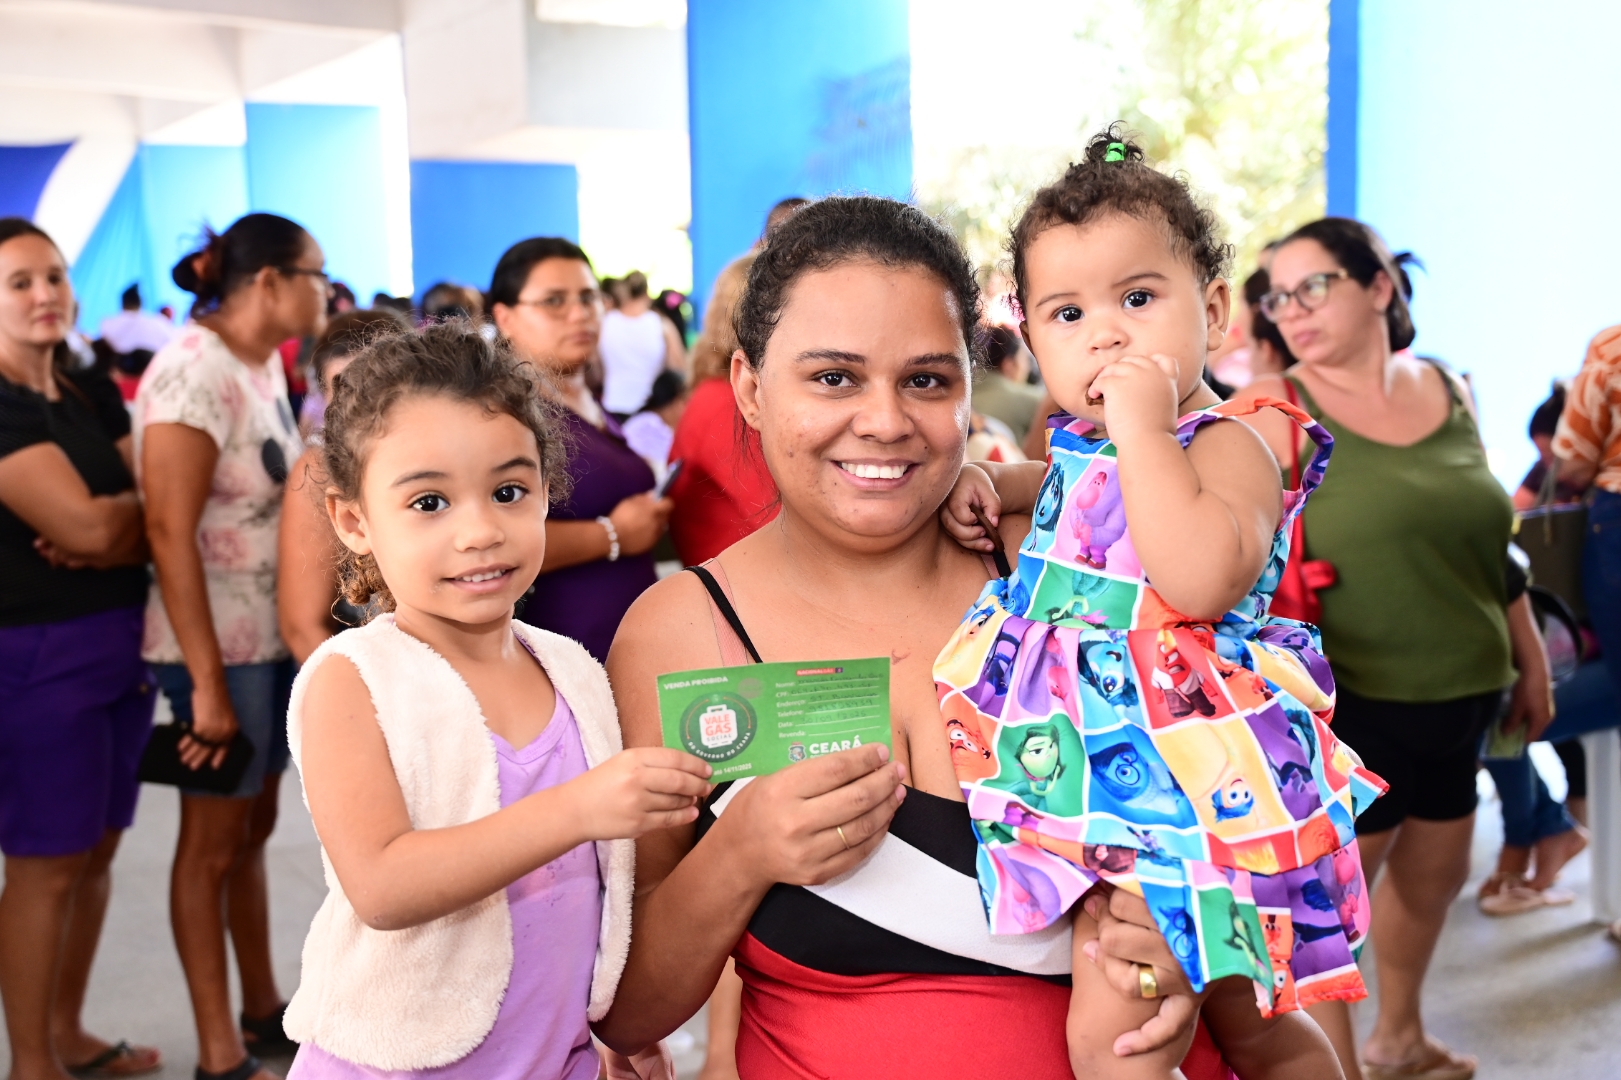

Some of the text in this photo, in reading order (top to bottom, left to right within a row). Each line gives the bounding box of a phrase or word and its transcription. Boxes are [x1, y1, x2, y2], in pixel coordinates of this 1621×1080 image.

[664, 676, 728, 690] VENDA PROIBIDA
[776, 699, 806, 708] Endereço:
[777, 710, 804, 718] Telefone:
[704, 713, 730, 725] VALE
[778, 721, 793, 729] Data:
[706, 734, 732, 742] SOCIAL
[778, 731, 806, 739] Revenda:
[809, 735, 863, 754] CEARÁ
[688, 741, 696, 750] DO
[696, 749, 725, 759] GOVERNO
